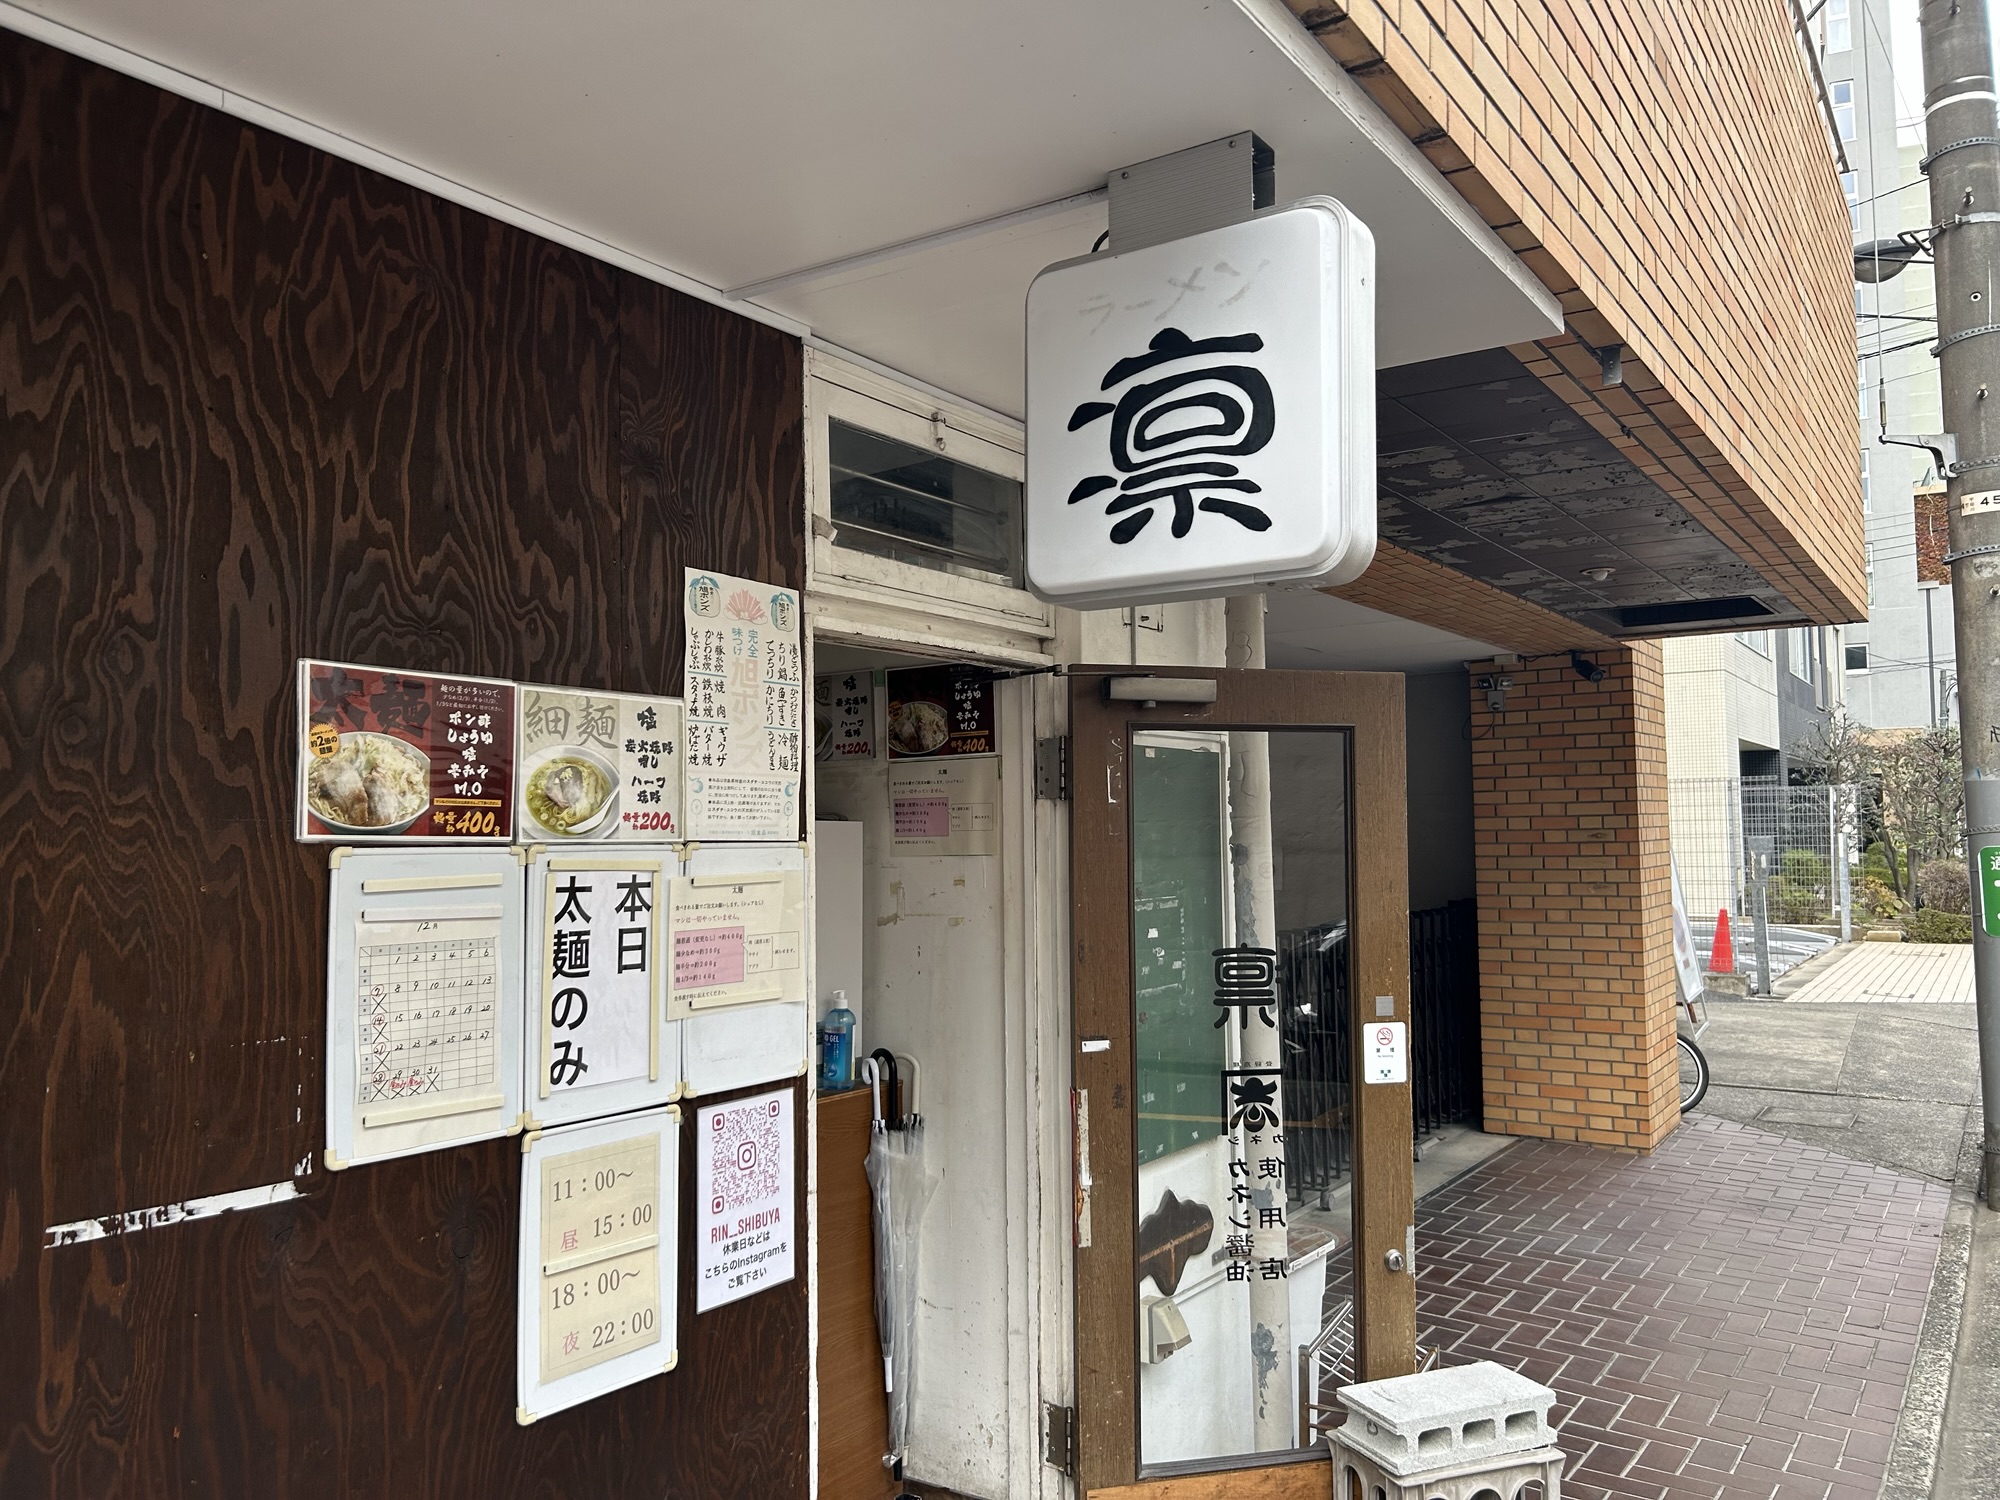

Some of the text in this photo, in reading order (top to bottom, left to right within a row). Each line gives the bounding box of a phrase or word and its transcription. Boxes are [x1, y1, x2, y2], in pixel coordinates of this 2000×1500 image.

[1079, 259, 1270, 336] ラーメン
[699, 586, 710, 612] 旭ポンズ
[689, 627, 700, 669] しゃぶしゃぶ
[732, 627, 743, 655] 味つけ
[748, 629, 758, 658] 完全
[714, 680, 726, 718] 焼肉
[955, 691, 981, 700] しょうゆ
[449, 710, 491, 728] ポン酢
[525, 691, 618, 749] 細麺
[637, 706, 657, 731] 塩
[960, 721, 977, 730] M.O
[447, 728, 493, 745] しょうゆ
[702, 726, 714, 766] バター焼
[717, 726, 728, 767] ギョウザ
[462, 746, 477, 762] 塩
[638, 755, 659, 769] 増し
[447, 763, 489, 779] 辛みそ
[631, 775, 666, 788] ハーフ
[454, 781, 482, 796] M.O
[637, 790, 662, 804] 焼豚
[417, 921, 438, 932] 12月
[614, 874, 652, 974] 本日
[395, 984, 401, 993] 8
[413, 981, 419, 991] 9
[430, 982, 439, 990] 10
[482, 976, 492, 985] 13
[550, 875, 593, 1086] 太麺のみ
[395, 1013, 403, 1022] 15
[414, 1011, 422, 1020] 16
[432, 1010, 440, 1018] 17
[449, 1007, 457, 1015] 18
[464, 1005, 472, 1014] 19
[481, 1004, 490, 1012] 20
[412, 1040, 420, 1048] 23
[429, 1038, 438, 1046] 24
[462, 1032, 472, 1041] 26
[480, 1031, 489, 1040] 27
[393, 1070, 402, 1080] 29
[427, 1066, 437, 1074] 31
[593, 1203, 652, 1238] 15:00
[560, 1229, 578, 1253] 昼
[723, 1231, 771, 1256] 休業日などは
[705, 1242, 787, 1279] こちらのInstagramを
[728, 1267, 767, 1289] ご覧下さい
[592, 1308, 654, 1349] 22:00
[562, 1331, 580, 1355] 夜
